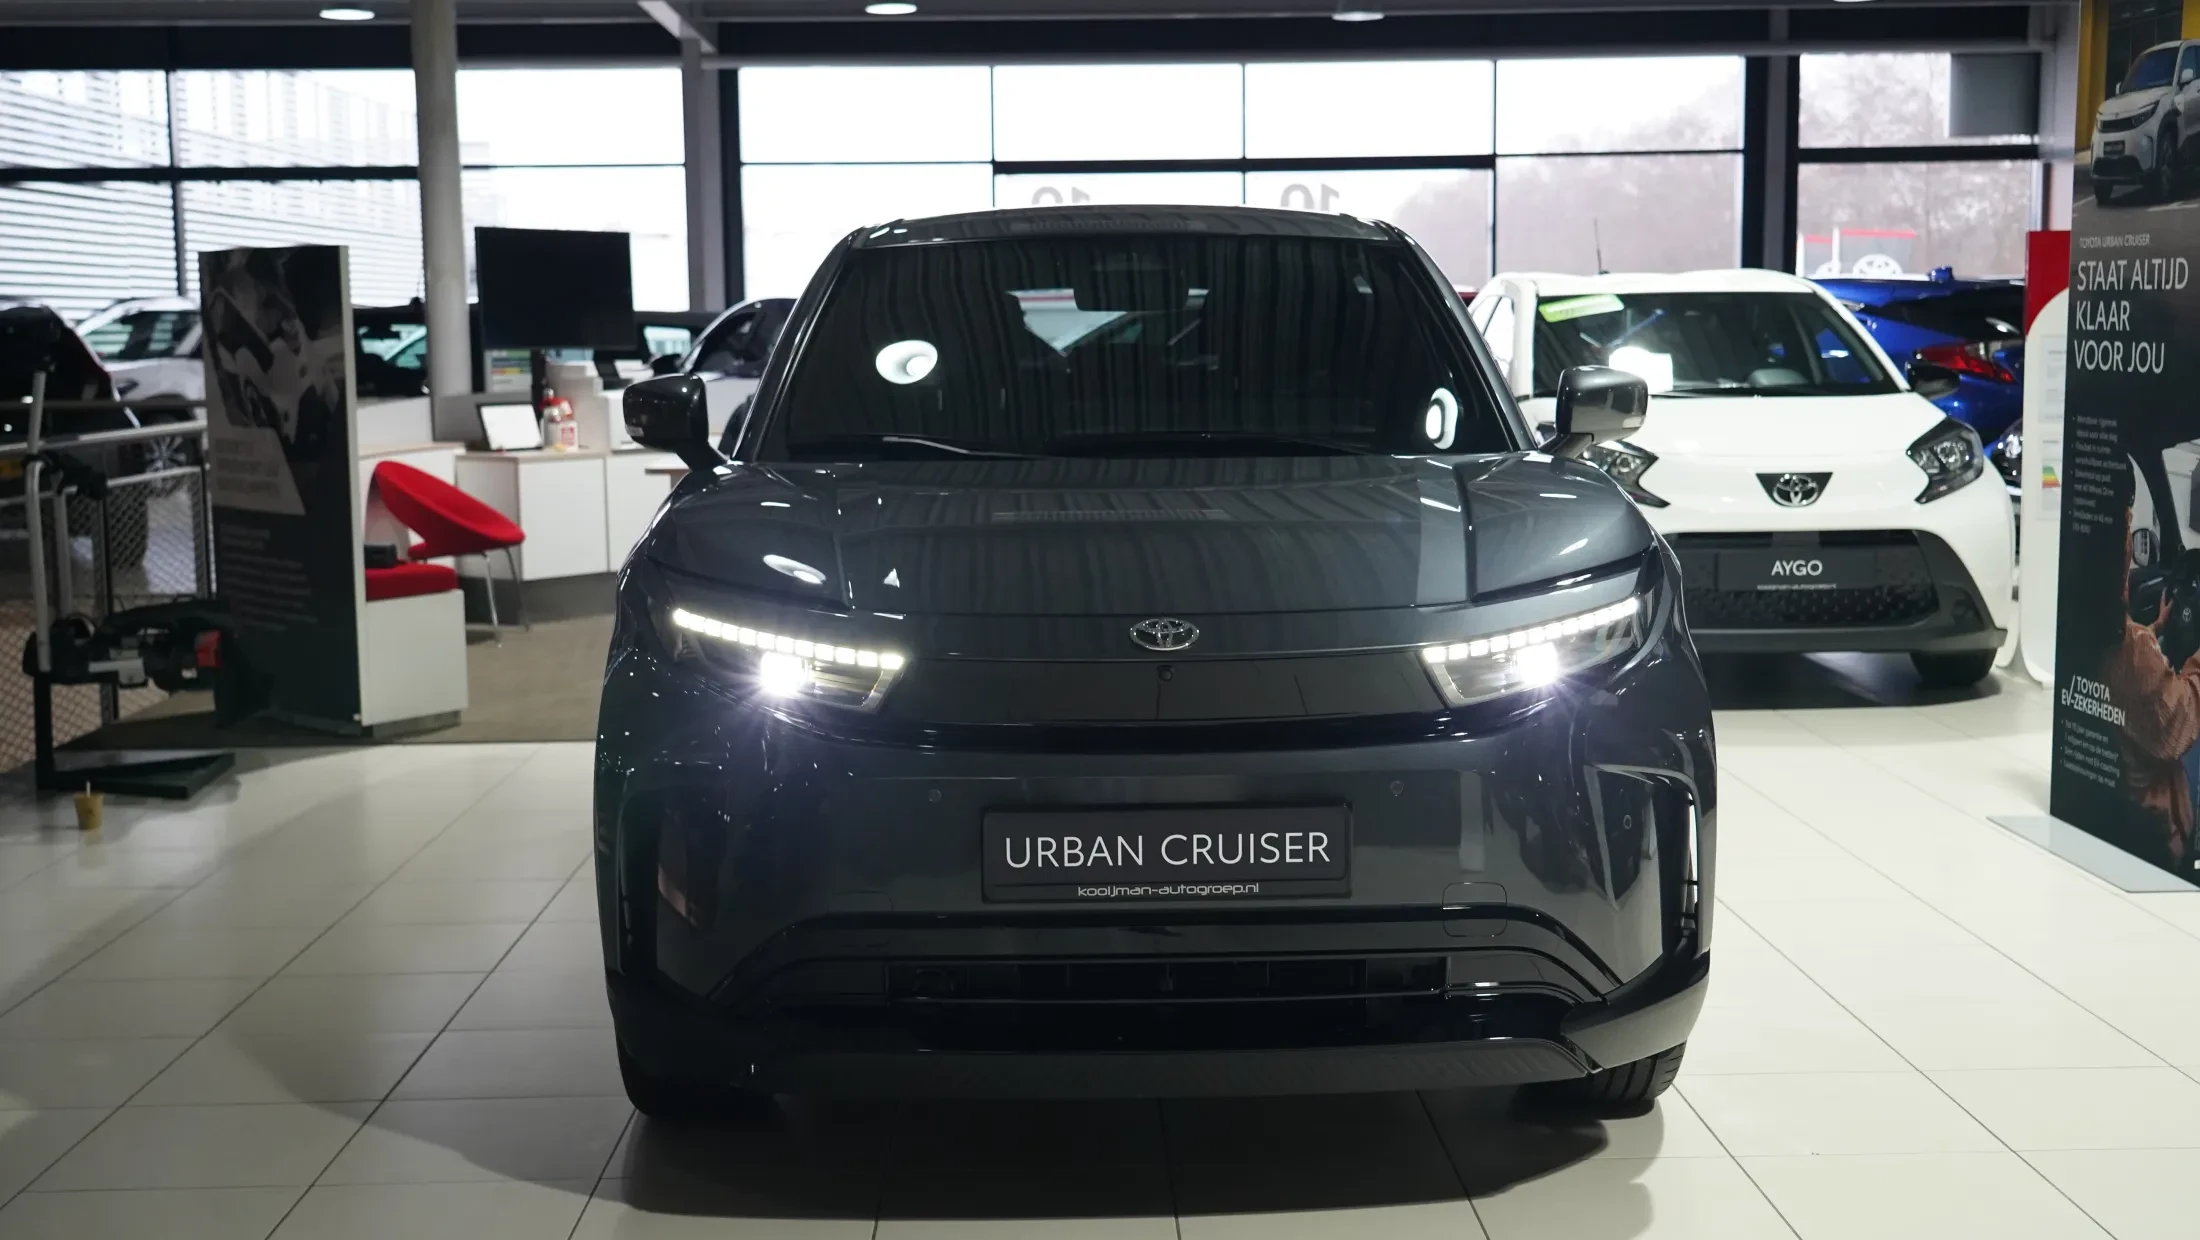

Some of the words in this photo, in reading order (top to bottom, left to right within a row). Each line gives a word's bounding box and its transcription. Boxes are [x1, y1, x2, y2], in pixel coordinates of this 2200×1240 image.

[2124, 233, 2150, 246] CRUISER
[2077, 259, 2127, 291] STAAT
[2130, 257, 2188, 290] ALTIJD
[2076, 300, 2130, 331] KLAAR
[2074, 339, 2123, 372] VOOR
[2127, 341, 2164, 374] JOU
[1771, 560, 1823, 576] AYGO
[2061, 681, 2126, 726] EV-ZEKERHEDEN
[2076, 676, 2111, 702] TOYOTA
[1005, 834, 1143, 868] URBAN
[1160, 831, 1331, 866] CRUISER
[1077, 882, 1259, 898] kooijman-autogroep.nl
